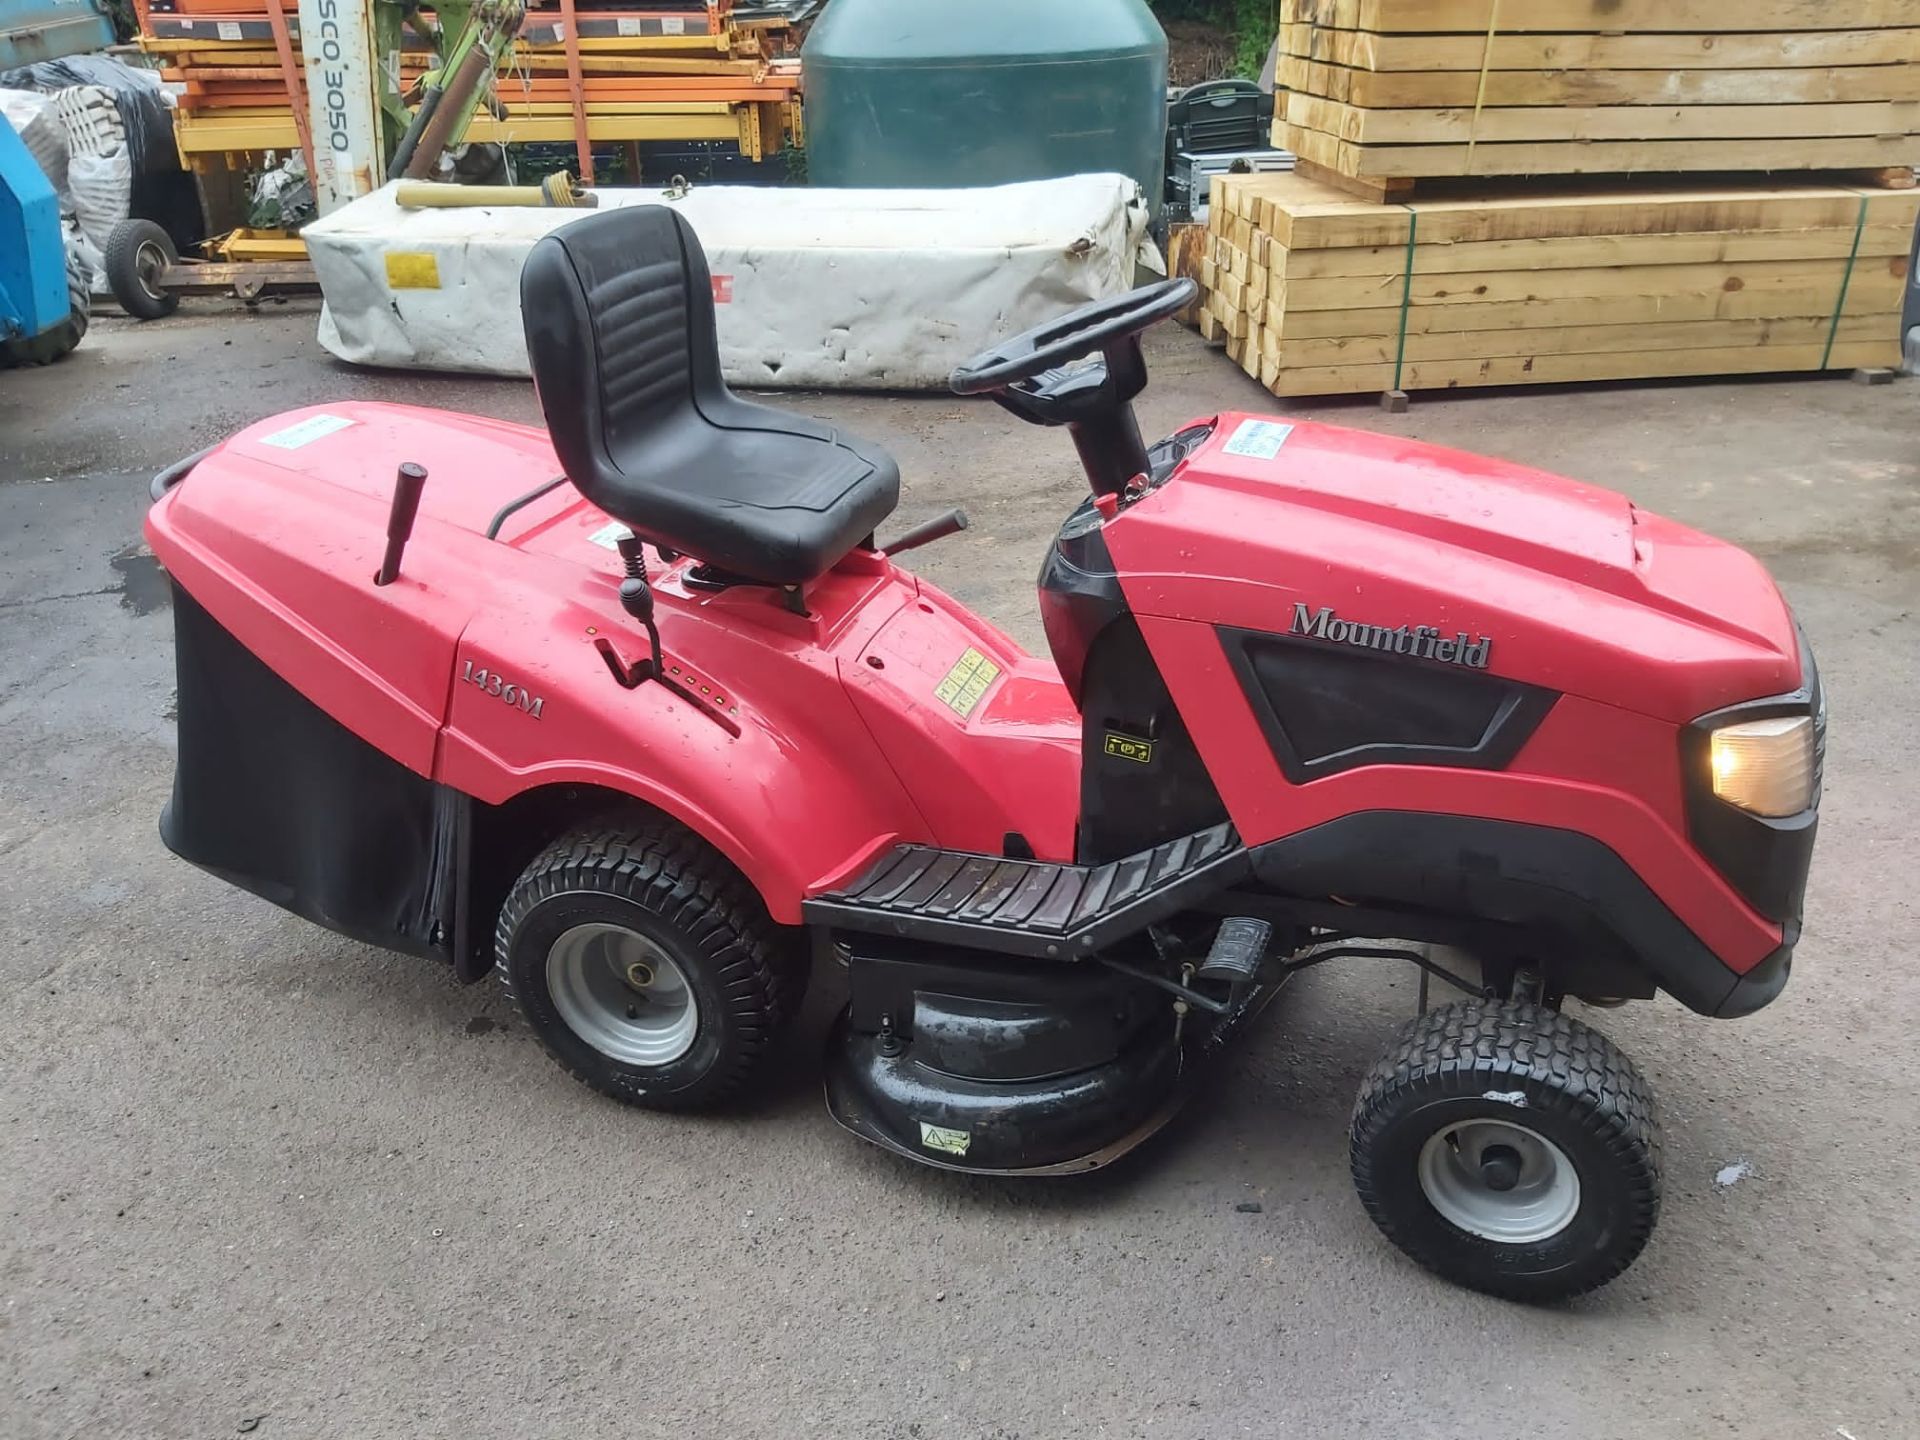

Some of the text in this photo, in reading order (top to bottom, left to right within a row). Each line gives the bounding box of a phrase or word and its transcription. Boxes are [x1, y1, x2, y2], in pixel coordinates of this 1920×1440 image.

[325, 70, 348, 152] 3050
[1288, 602, 1491, 668] Mountfield
[460, 660, 544, 720] 1436M
